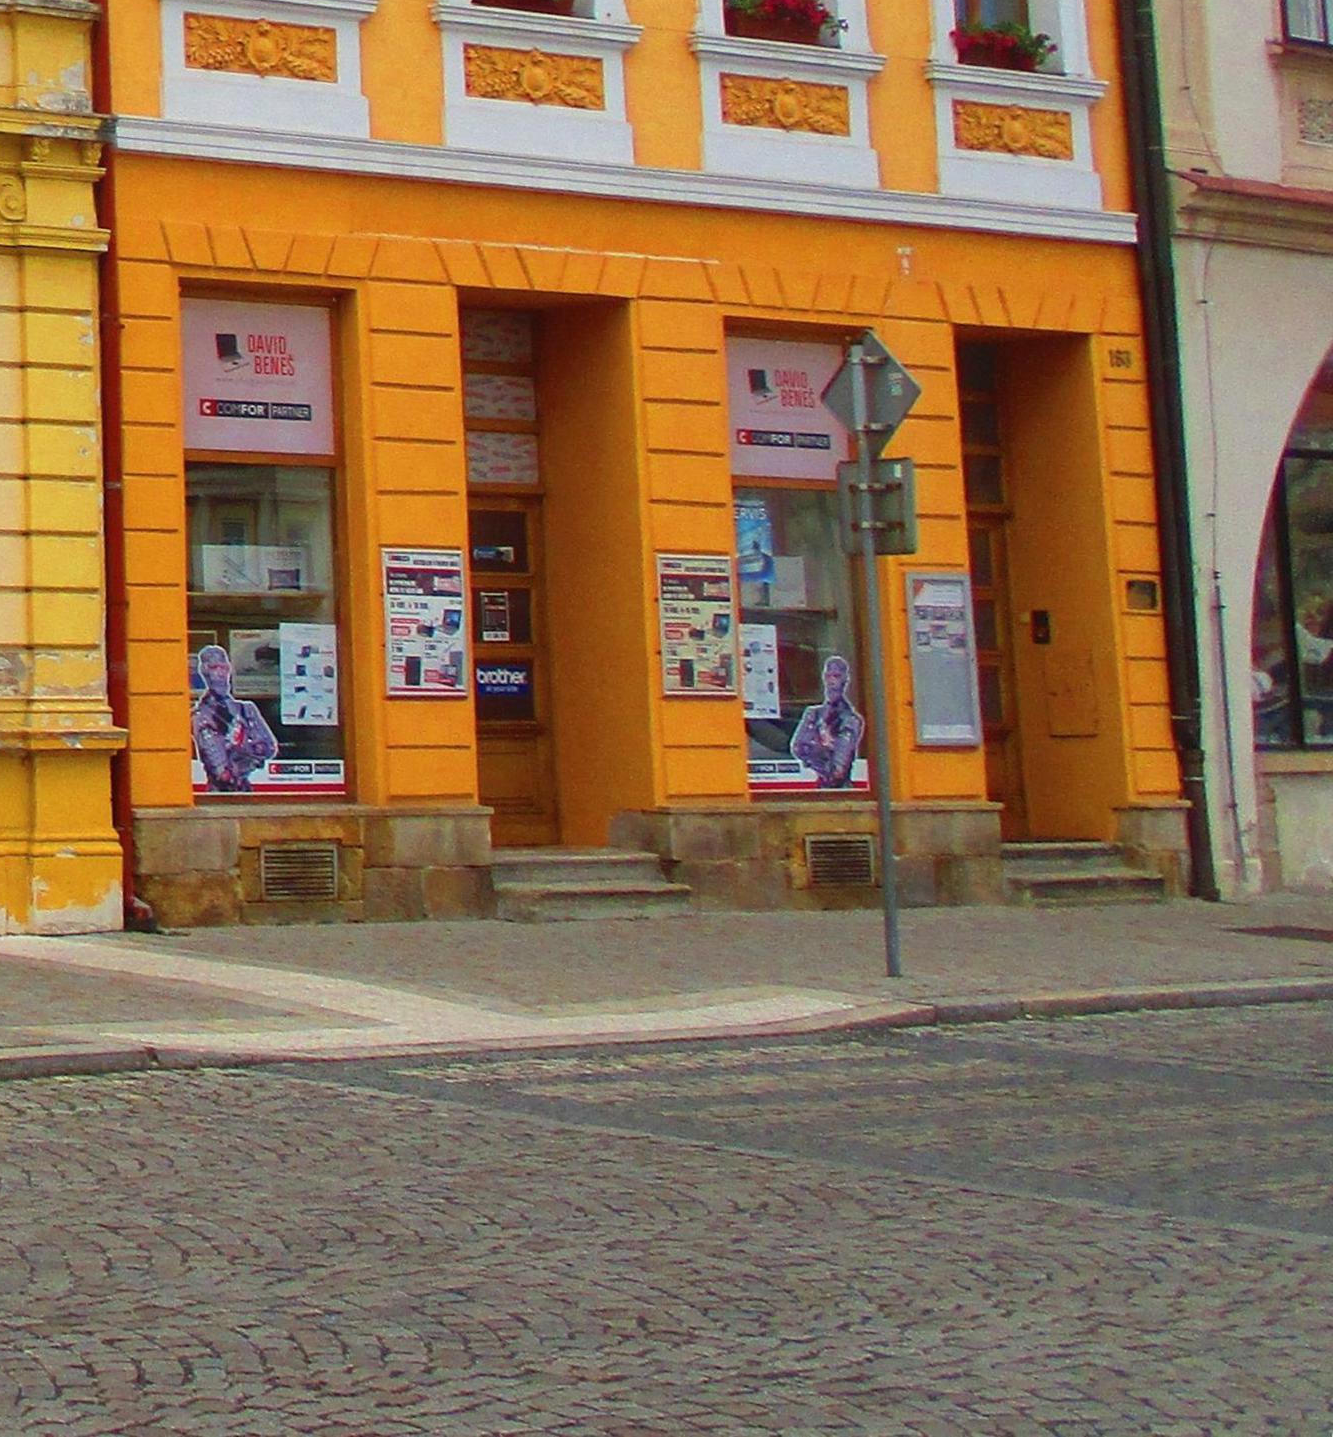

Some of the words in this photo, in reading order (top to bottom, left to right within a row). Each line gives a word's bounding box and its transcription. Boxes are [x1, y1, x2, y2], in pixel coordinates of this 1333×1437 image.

[247, 334, 286, 354] DAVID
[254, 355, 295, 376] BENEŠ
[773, 369, 808, 388] DAVID
[780, 388, 815, 408] BENEŠ
[217, 402, 265, 416] COMFOR
[476, 668, 526, 684] brother
